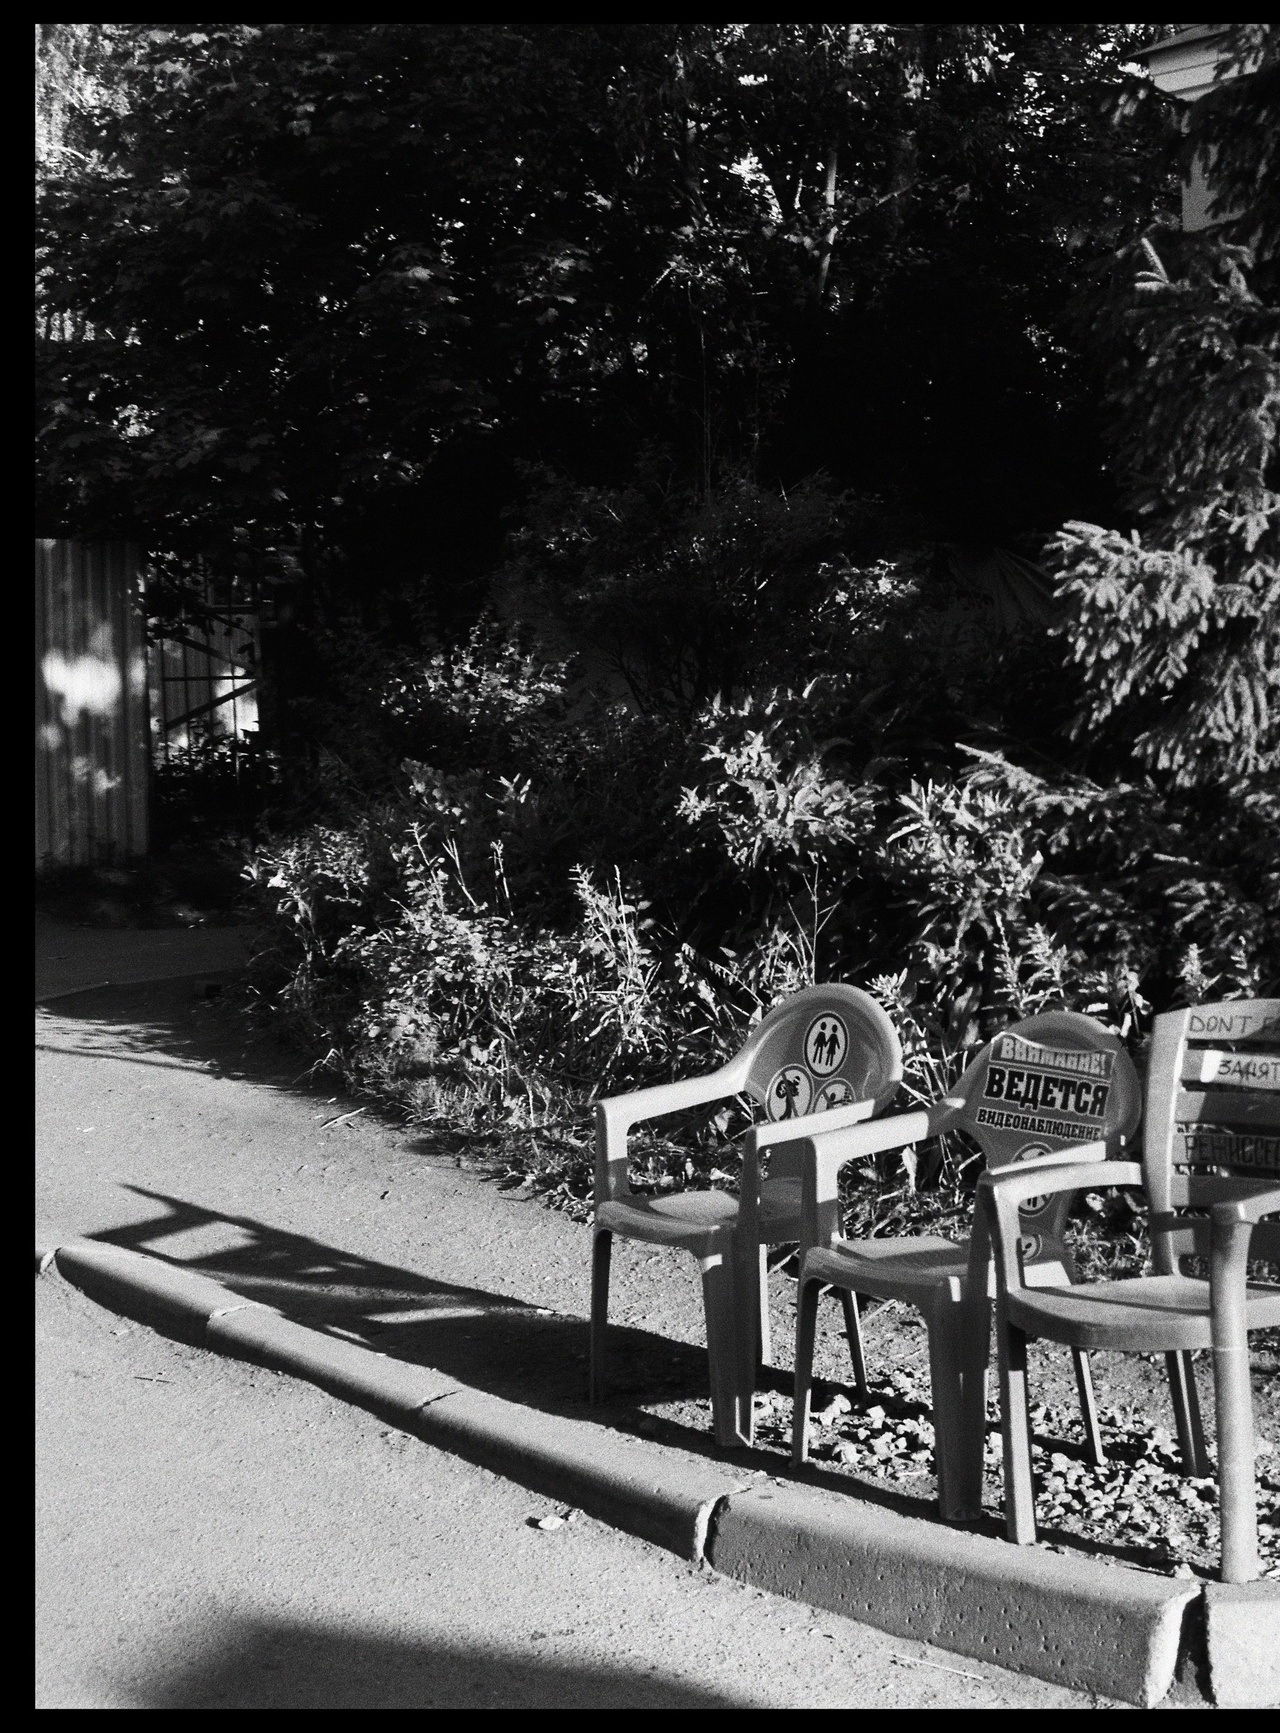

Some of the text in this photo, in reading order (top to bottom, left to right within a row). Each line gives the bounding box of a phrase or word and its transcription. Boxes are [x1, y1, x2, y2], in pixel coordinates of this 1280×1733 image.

[1188, 1014, 1253, 1034] DON'T
[983, 1066, 1110, 1117] ВЕДЕТСЯ
[976, 1108, 1102, 1142] ВИДЕОНАБЛЮДЕНИЕ
